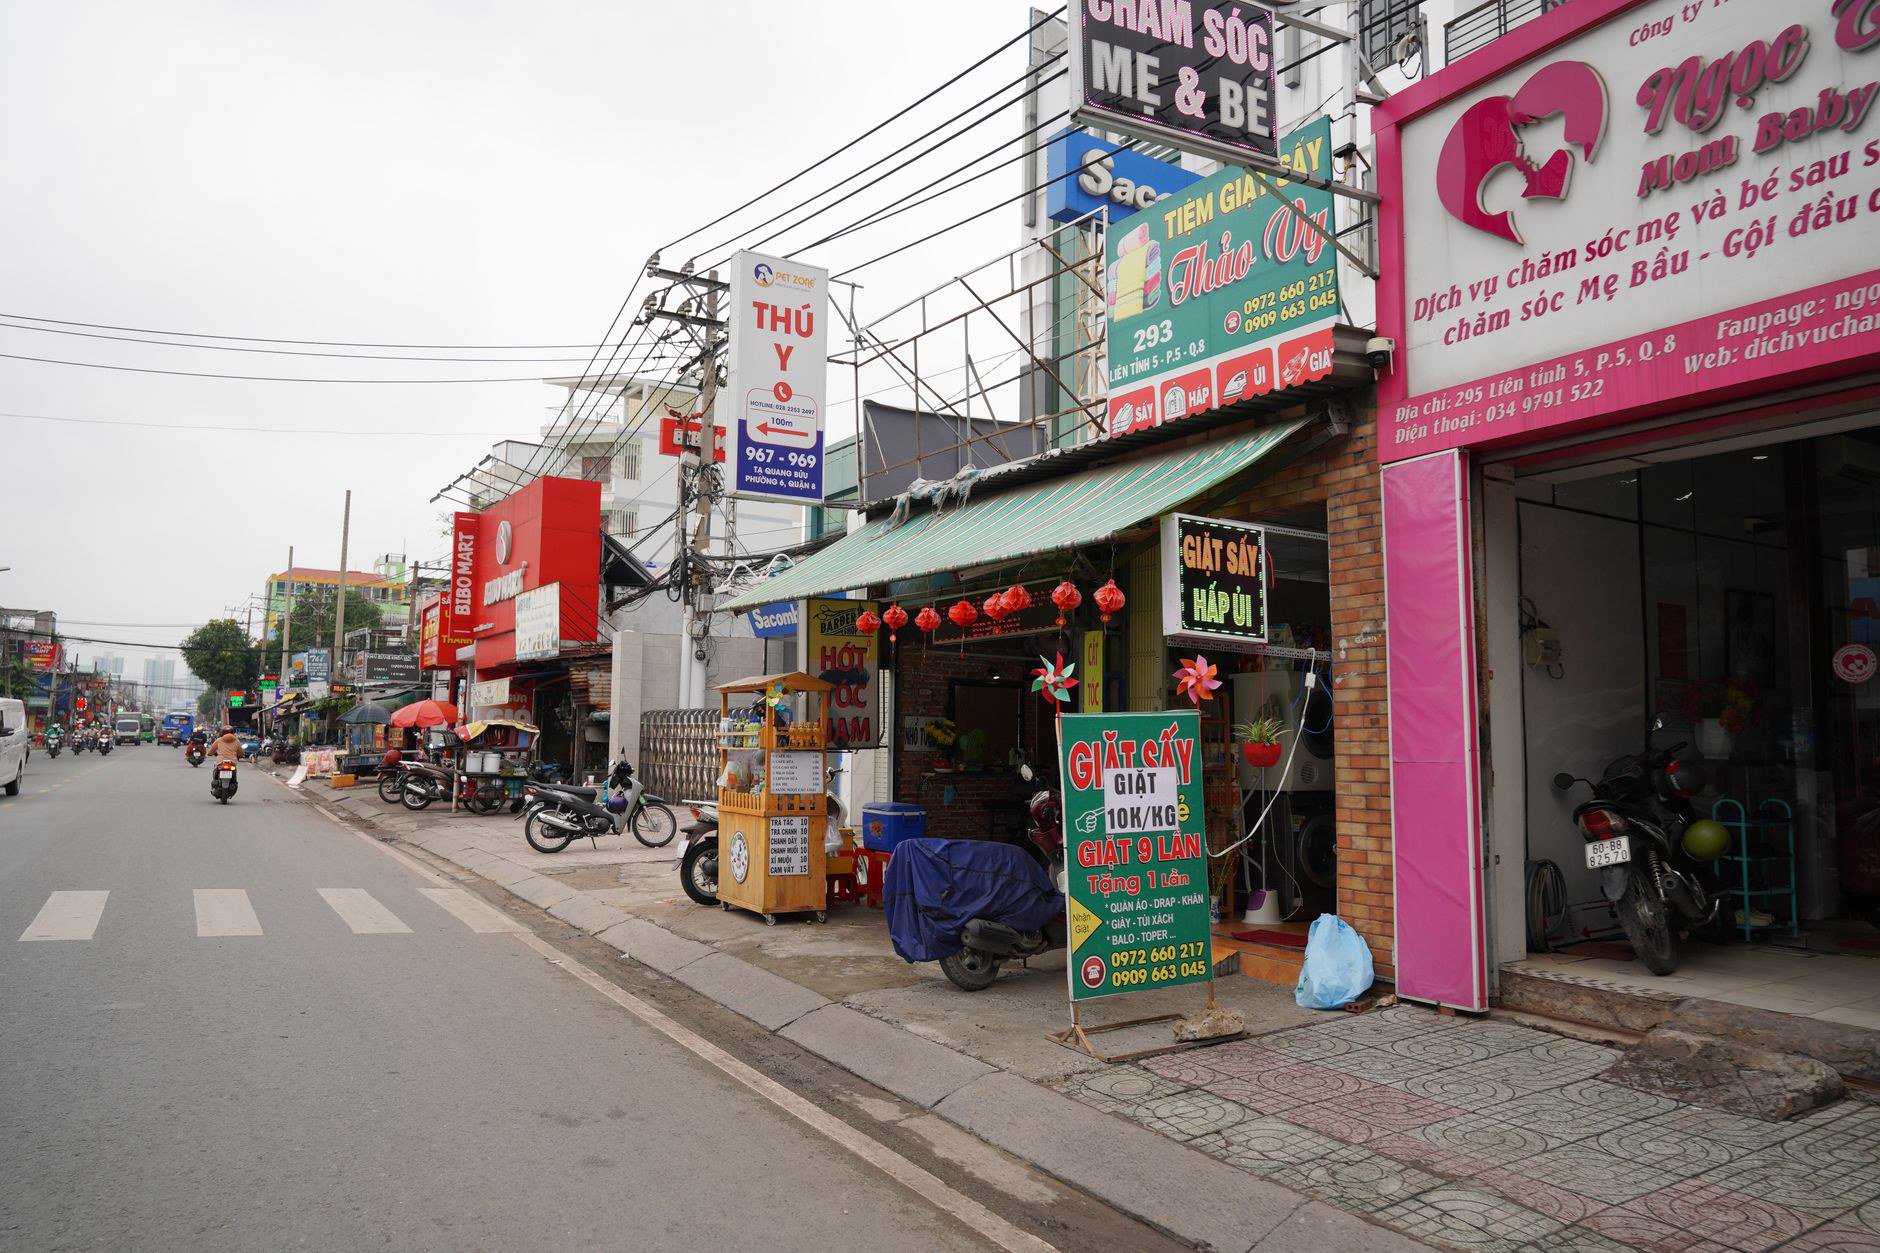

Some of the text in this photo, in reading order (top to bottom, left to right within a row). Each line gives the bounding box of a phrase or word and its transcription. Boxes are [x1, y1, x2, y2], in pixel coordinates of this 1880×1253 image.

[1203, 7, 1270, 72] SÓC
[1629, 15, 1675, 47] Công
[1091, 38, 1270, 138] MẸ & BÉ
[1636, 24, 1808, 134] Ngọc
[1637, 135, 1738, 198] Mom
[1752, 81, 1880, 154] Baby
[1164, 192, 1214, 240] TIỆM
[1168, 197, 1331, 306] Thảo Vy
[1413, 284, 1462, 322] Dịch
[1468, 275, 1499, 302] vụ
[1506, 248, 1577, 288] chăm
[1585, 227, 1630, 263] sóc
[1636, 211, 1681, 246] mẹ
[1691, 188, 1727, 225] và
[1738, 166, 1779, 211] bé
[1789, 150, 1851, 192] sau
[775, 272, 790, 283] PET
[1443, 309, 1510, 346] chăm
[1520, 289, 1564, 321] sóc
[1576, 273, 1619, 305] Mẹ
[1629, 246, 1690, 288] Bầu
[1722, 215, 1777, 259] Gội
[1789, 190, 1859, 238] đầu
[1243, 268, 1335, 316] 0972 660 217
[752, 300, 814, 338] THÚ
[1244, 288, 1337, 334] 0909 663 045
[1716, 298, 1827, 341] Fanpage:
[1133, 319, 1173, 353] 293
[773, 343, 794, 371] Y
[1109, 363, 1129, 383] LIÊN
[1130, 354, 1150, 376] TỈNH
[1152, 354, 1159, 369] 5
[1166, 348, 1182, 364] P.5
[1189, 339, 1206, 357] Q.8
[1309, 347, 1335, 373] GI
[1684, 346, 1739, 375] Web:
[1253, 363, 1266, 386] ỦI
[1395, 333, 1677, 424] Địa chỉ: 295 Liên tỉnh 5, P.5, Q.8
[750, 400, 774, 409] HOTLINE:
[1135, 400, 1154, 423] SẤY
[1188, 384, 1210, 408] HẤP
[1395, 379, 1605, 444] Điện thoại: 034 9791 522
[771, 417, 793, 427] 100m
[745, 446, 775, 463] 967
[788, 452, 817, 468] 969
[753, 466, 763, 475] TẠ
[765, 467, 792, 477] QUANG
[745, 475, 778, 486] PHƯỜNG
[788, 480, 810, 491] QUẬN
[1183, 531, 1258, 577] GIẶT SẤY
[455, 532, 474, 616] BIBO MART
[1193, 580, 1252, 628] HẤP ỦI
[1142, 721, 1194, 786] SẤY
[1114, 769, 1156, 799] GIẶT
[801, 818, 808, 826] 10
[1107, 804, 1176, 831] 10K/KG
[1078, 828, 1201, 871] GIẶT 9 LẦN
[1087, 868, 1190, 898] Tặng 1 Lần
[1135, 898, 1148, 911] ÁO
[1154, 897, 1176, 909] DRAP
[1111, 912, 1174, 930] GIÀY TÚI XÁCH
[1112, 929, 1168, 945] BALO TOPER
[1111, 941, 1204, 968] 0972 660 217
[1111, 960, 1206, 987] 0909 663 045
